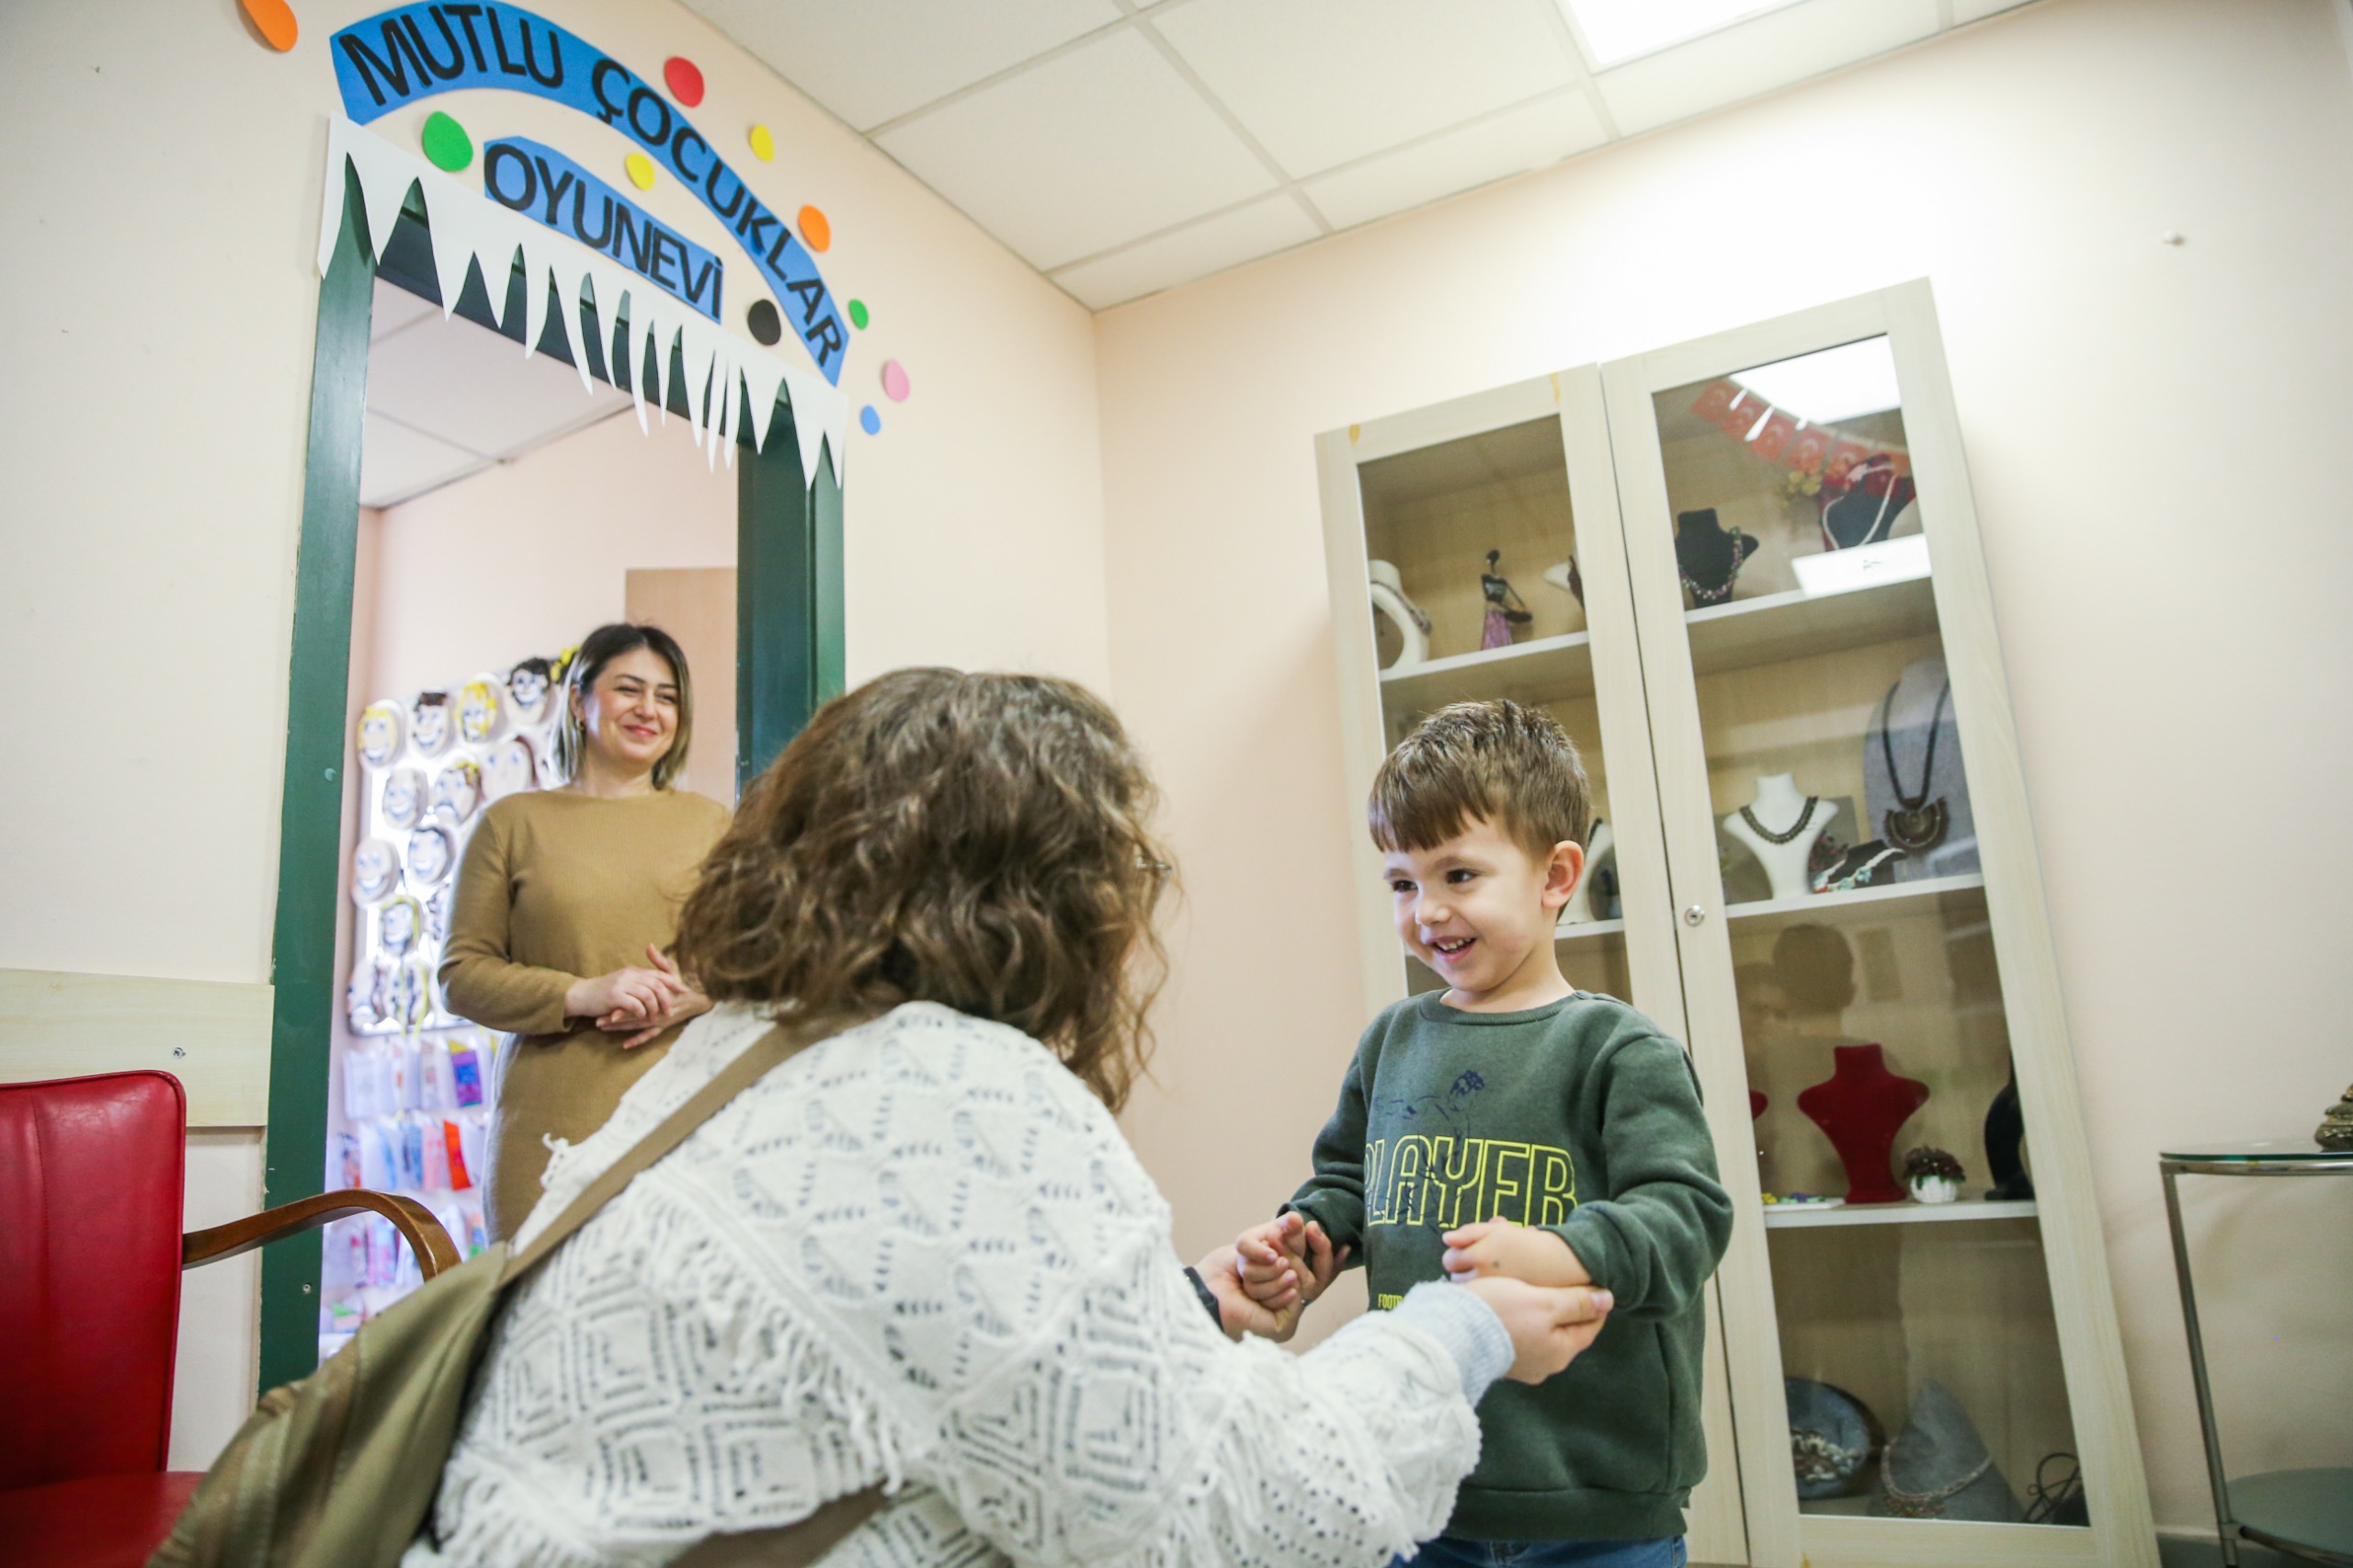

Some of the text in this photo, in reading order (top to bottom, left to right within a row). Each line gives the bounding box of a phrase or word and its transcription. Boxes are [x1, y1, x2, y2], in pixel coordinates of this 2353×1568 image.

[338, 5, 842, 366] MUTLU ÇOCUKLAR
[484, 143, 722, 317] OYUNEVİ
